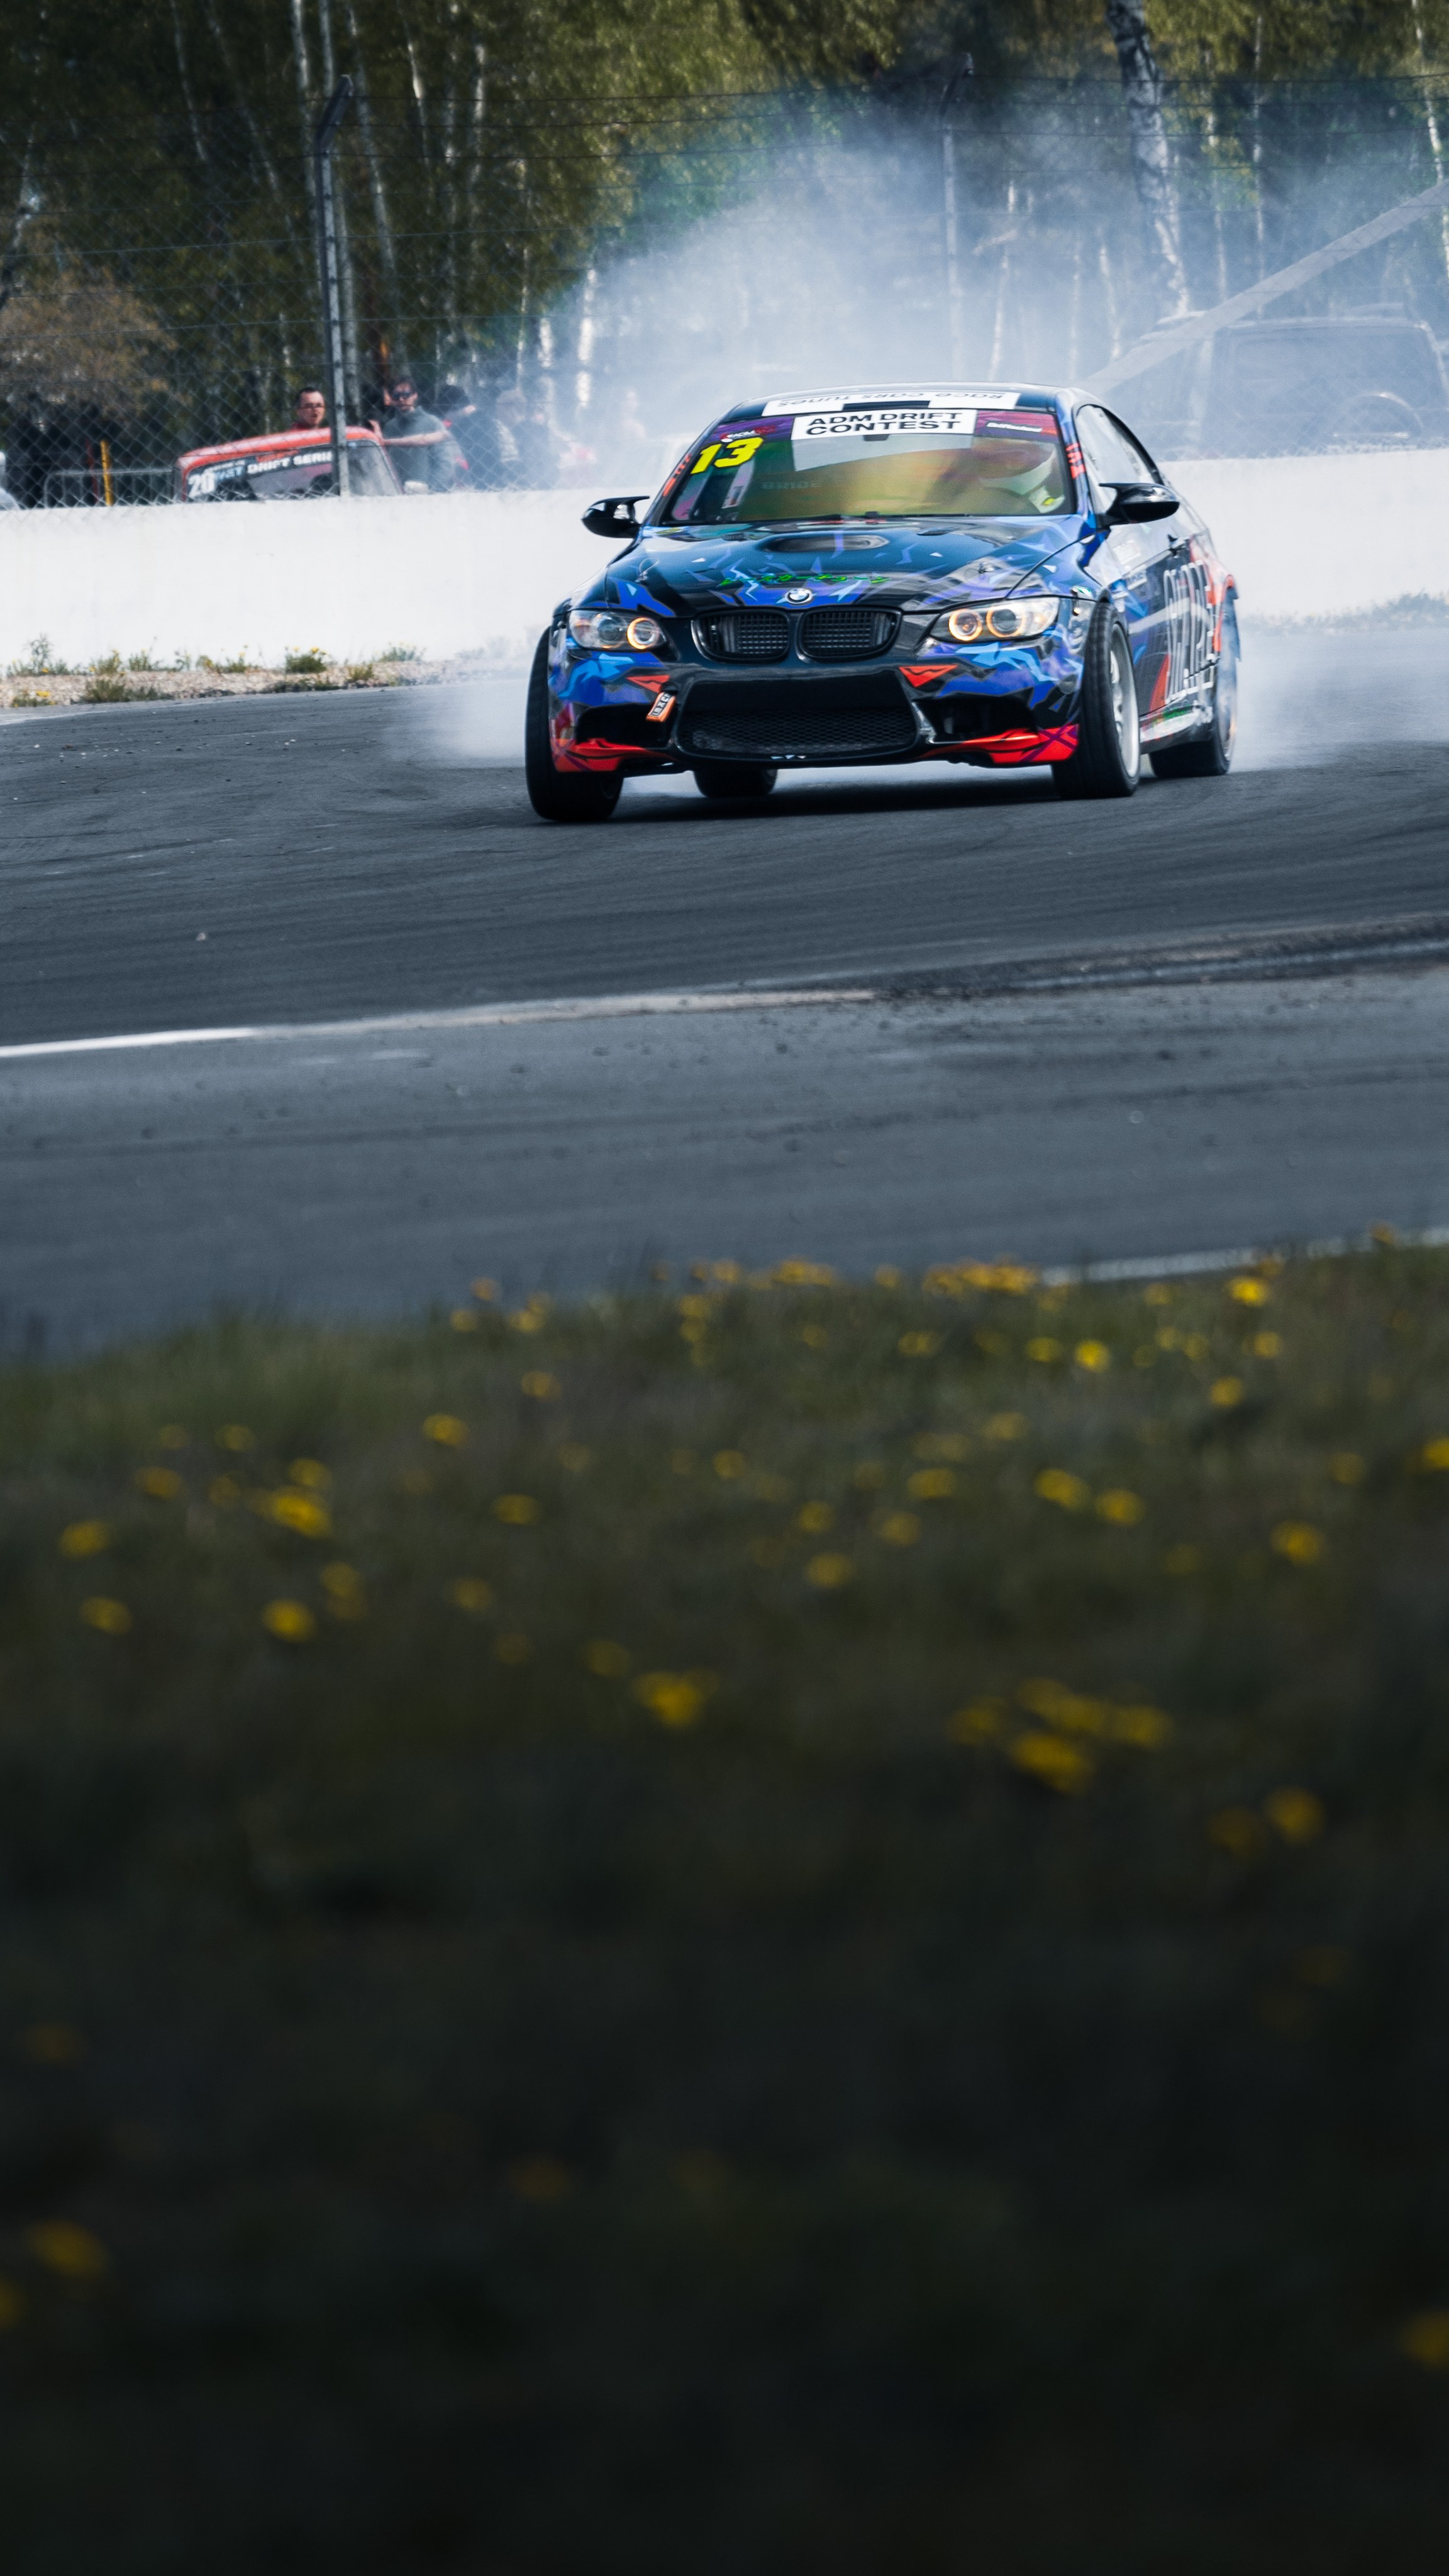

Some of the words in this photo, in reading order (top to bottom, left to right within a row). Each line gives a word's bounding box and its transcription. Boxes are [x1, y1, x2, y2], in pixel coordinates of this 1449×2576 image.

[806, 421, 961, 436] CONTEST
[808, 414, 877, 426] ADM
[880, 412, 963, 421] DRIFT
[691, 437, 763, 474] 13
[188, 472, 215, 498] 20
